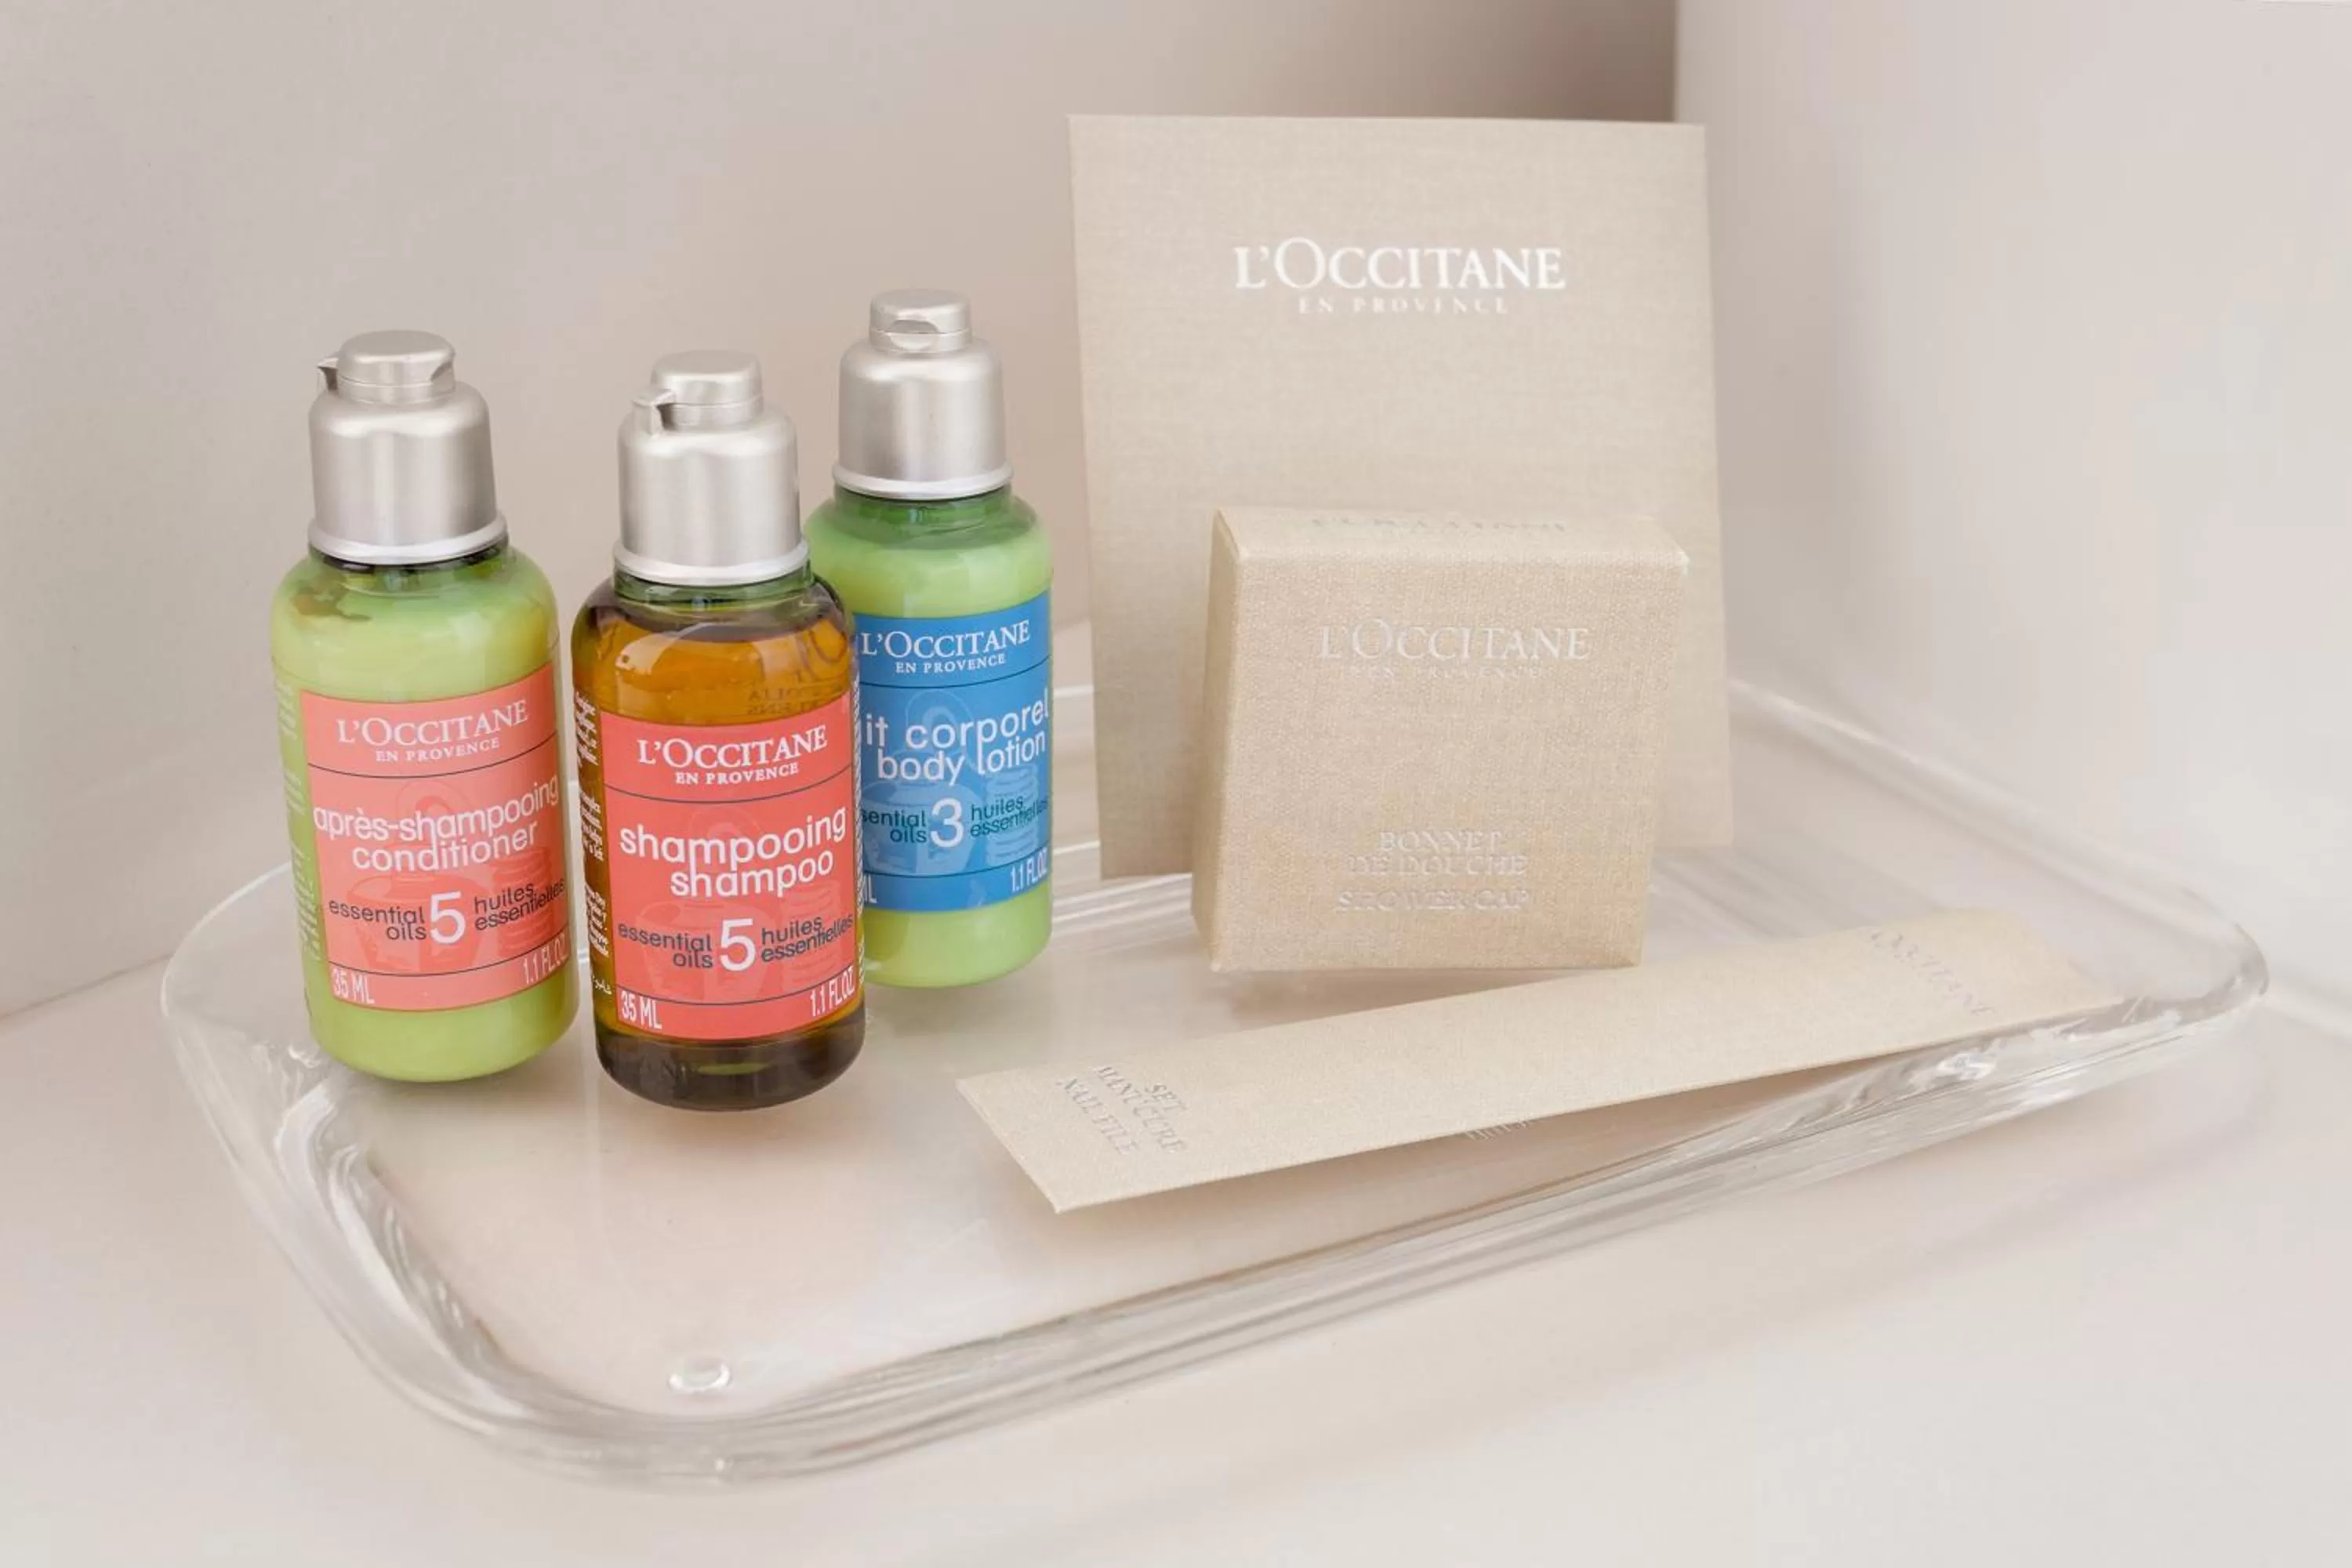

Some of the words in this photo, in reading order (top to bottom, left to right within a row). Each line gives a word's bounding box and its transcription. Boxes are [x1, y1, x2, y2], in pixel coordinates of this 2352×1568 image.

[1234, 236, 1566, 290] L'OCCITANE
[1299, 297, 1333, 314] EN
[1353, 297, 1508, 314] PROVENCE
[862, 619, 1031, 659] L'OCCITANE
[1317, 617, 1591, 660] L'OCCITANE
[895, 661, 916, 673] EN
[924, 653, 1006, 673] PROVENCE
[337, 700, 529, 746] L'OCCITANE
[866, 713, 888, 747] it
[906, 687, 1049, 754] corporel
[376, 749, 398, 763] EN
[406, 737, 502, 763] PROVENCE
[637, 724, 828, 768] L'OCCITANE
[877, 746, 965, 786] body
[978, 729, 1047, 776] lotion
[675, 771, 699, 785] EN
[706, 762, 800, 785] PROVENCE
[313, 773, 560, 846] après-shampooing
[861, 810, 927, 829] sential
[931, 797, 965, 849] 3
[971, 796, 1023, 822] huiles
[352, 818, 539, 872] conditioner
[619, 807, 847, 872] shampooing
[890, 824, 927, 844] oils
[670, 850, 834, 898] shampoo
[1010, 862, 1023, 892] 1.1
[328, 897, 426, 925] essential
[474, 882, 535, 915] huiles
[475, 877, 565, 931] essentielles
[387, 919, 427, 941] oils
[430, 891, 466, 944] 5
[762, 916, 822, 946] huiles
[618, 921, 712, 952] essential
[720, 918, 757, 972] 5
[761, 913, 854, 962] essentielles
[523, 952, 539, 985] 1.1
[673, 948, 713, 969] oils
[331, 968, 351, 997] 35
[352, 975, 376, 1005] ML
[810, 983, 826, 1018] 1.1
[620, 989, 637, 1020] 35
[639, 996, 662, 1031] ML
[1145, 1083, 1187, 1111] SET
